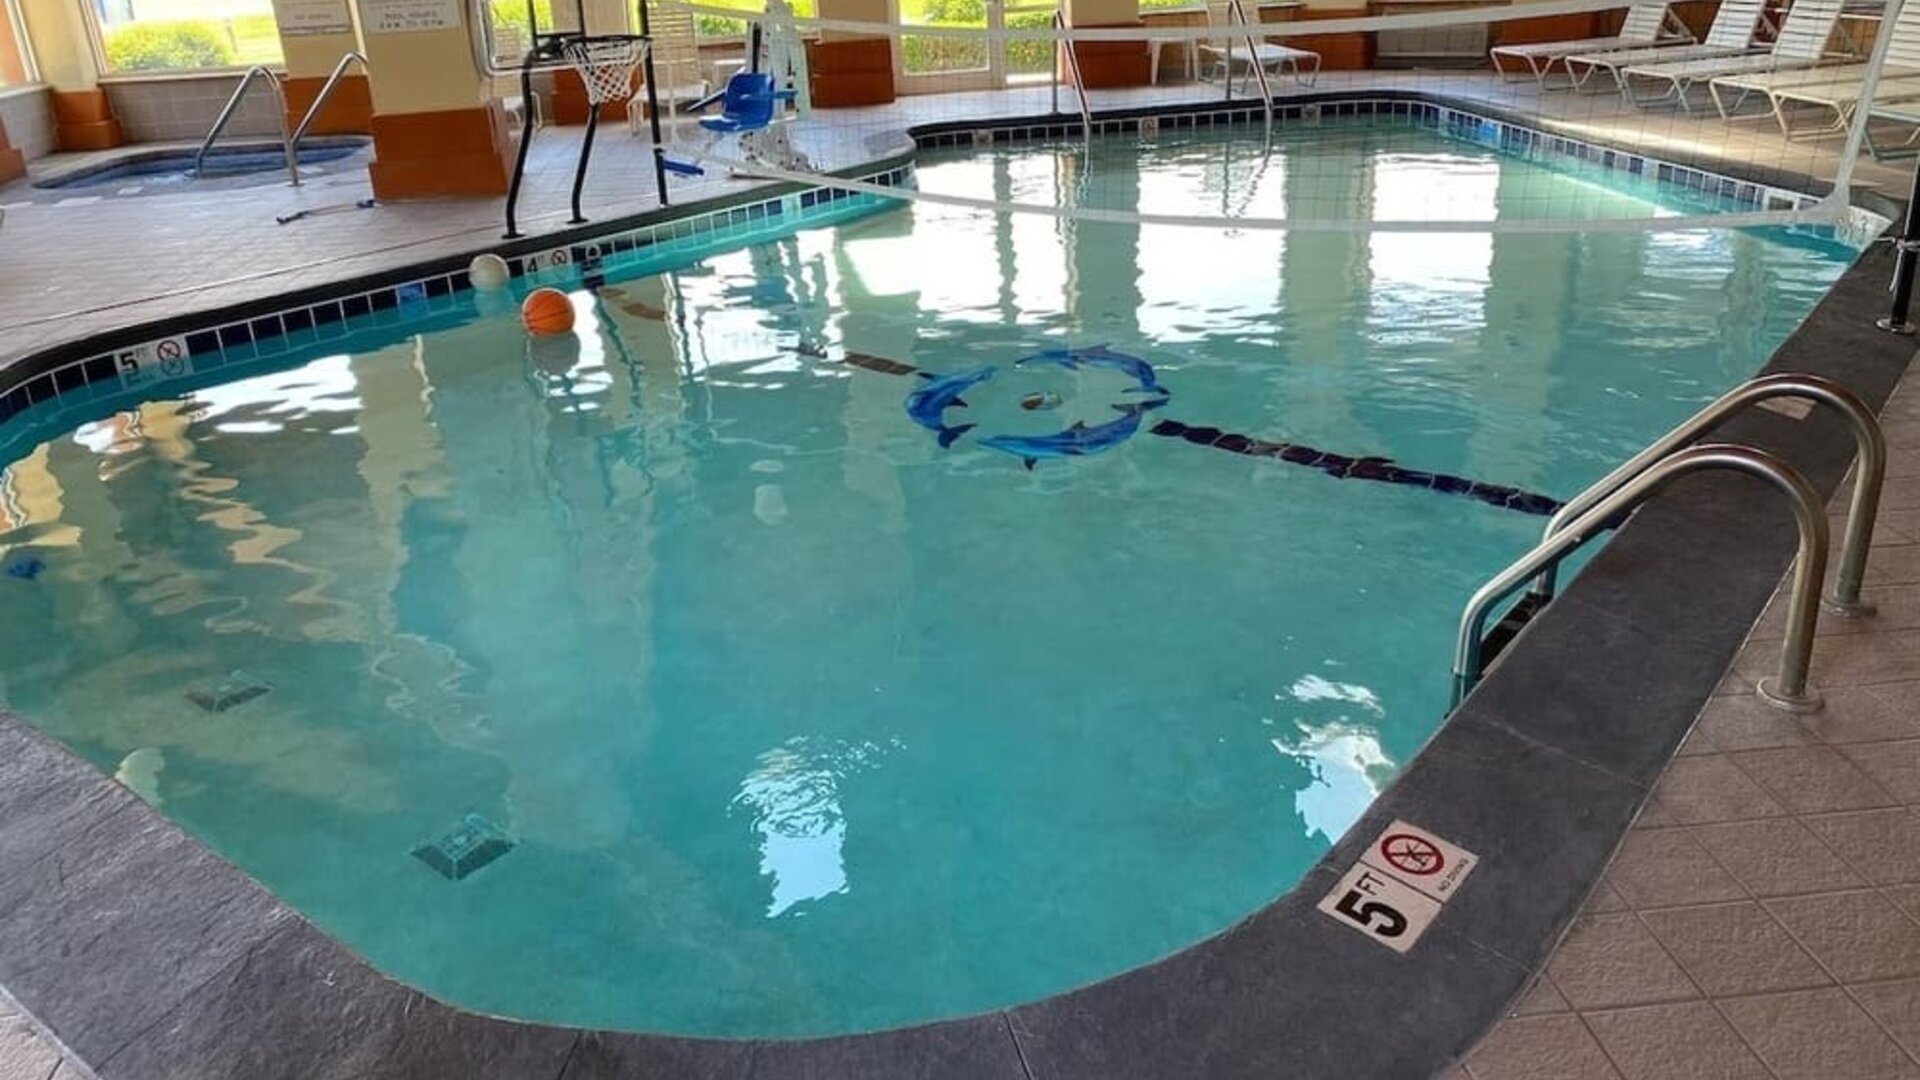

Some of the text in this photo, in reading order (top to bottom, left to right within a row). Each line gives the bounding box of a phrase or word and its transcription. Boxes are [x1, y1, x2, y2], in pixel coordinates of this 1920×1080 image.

[120, 352, 138, 374] 5
[1335, 871, 1408, 938] 5 FT
